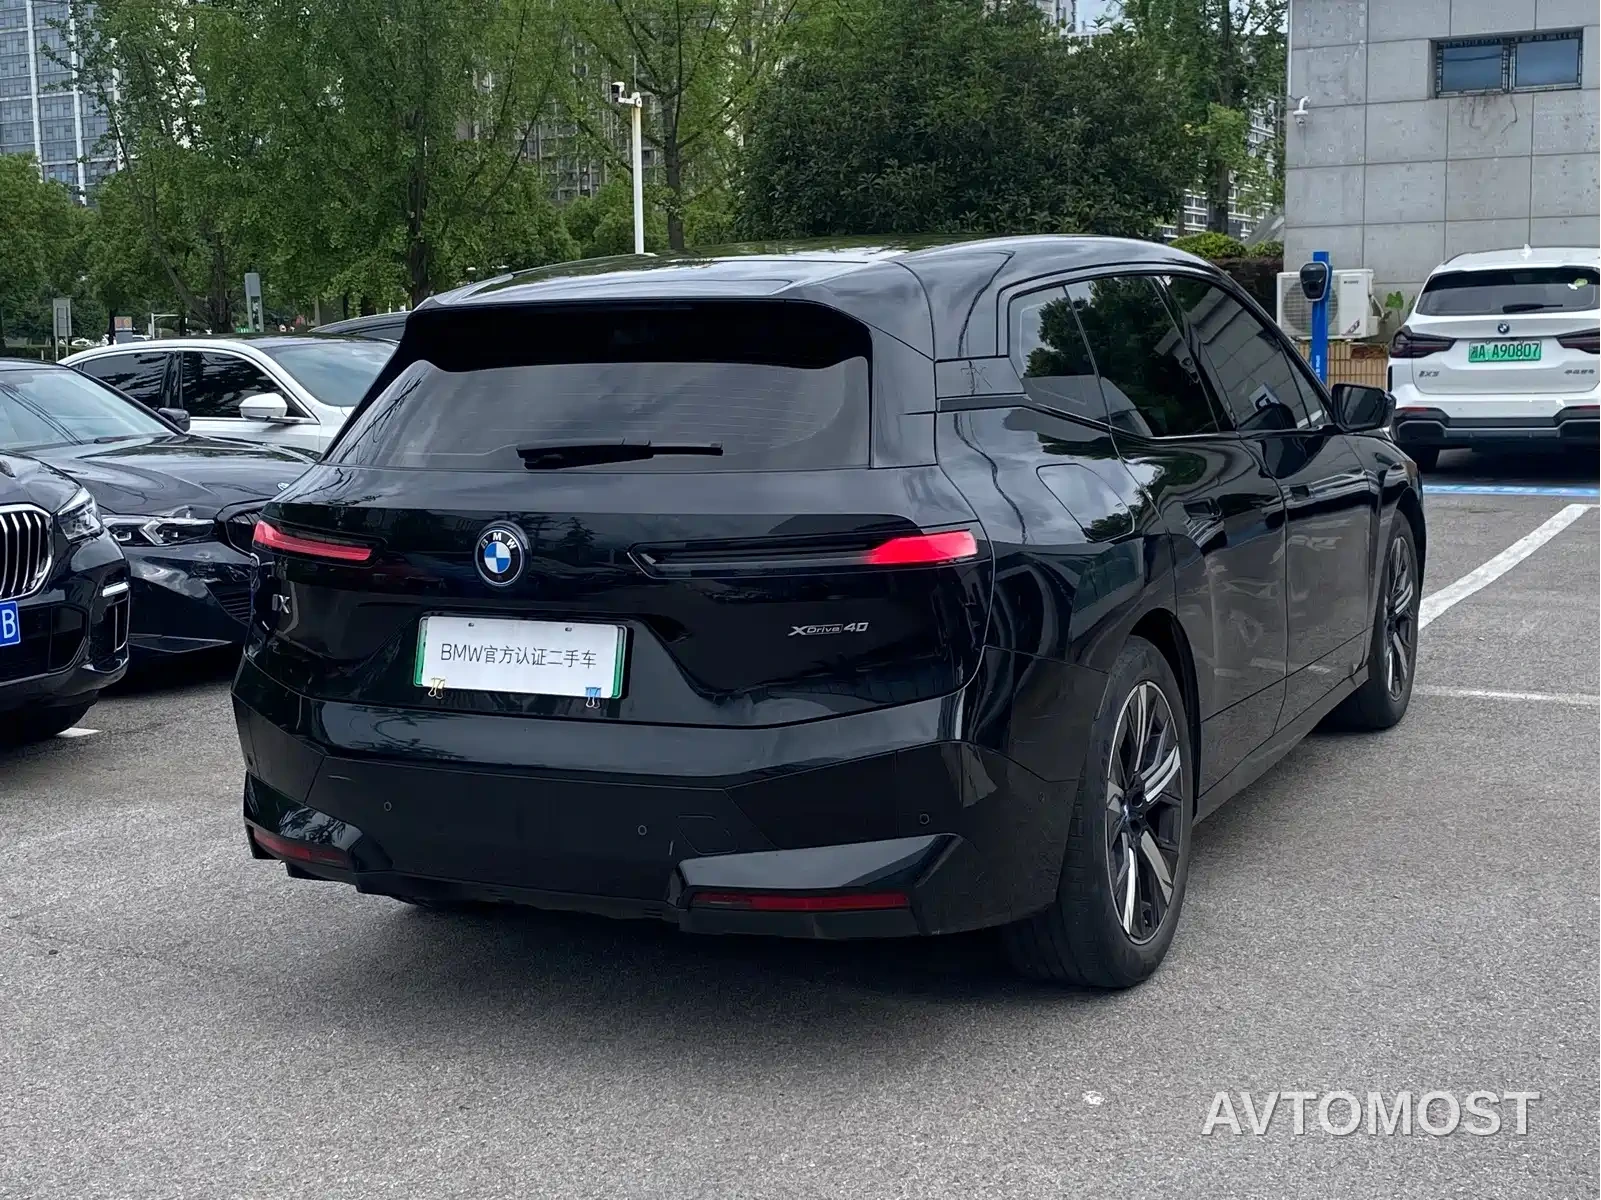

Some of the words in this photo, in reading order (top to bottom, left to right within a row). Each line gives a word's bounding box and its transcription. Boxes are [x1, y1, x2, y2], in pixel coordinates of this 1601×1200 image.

[1492, 343, 1539, 358] A90807
[480, 532, 517, 549] BMW
[844, 622, 869, 632] 40
[440, 643, 597, 668] BMW官方认证二手车
